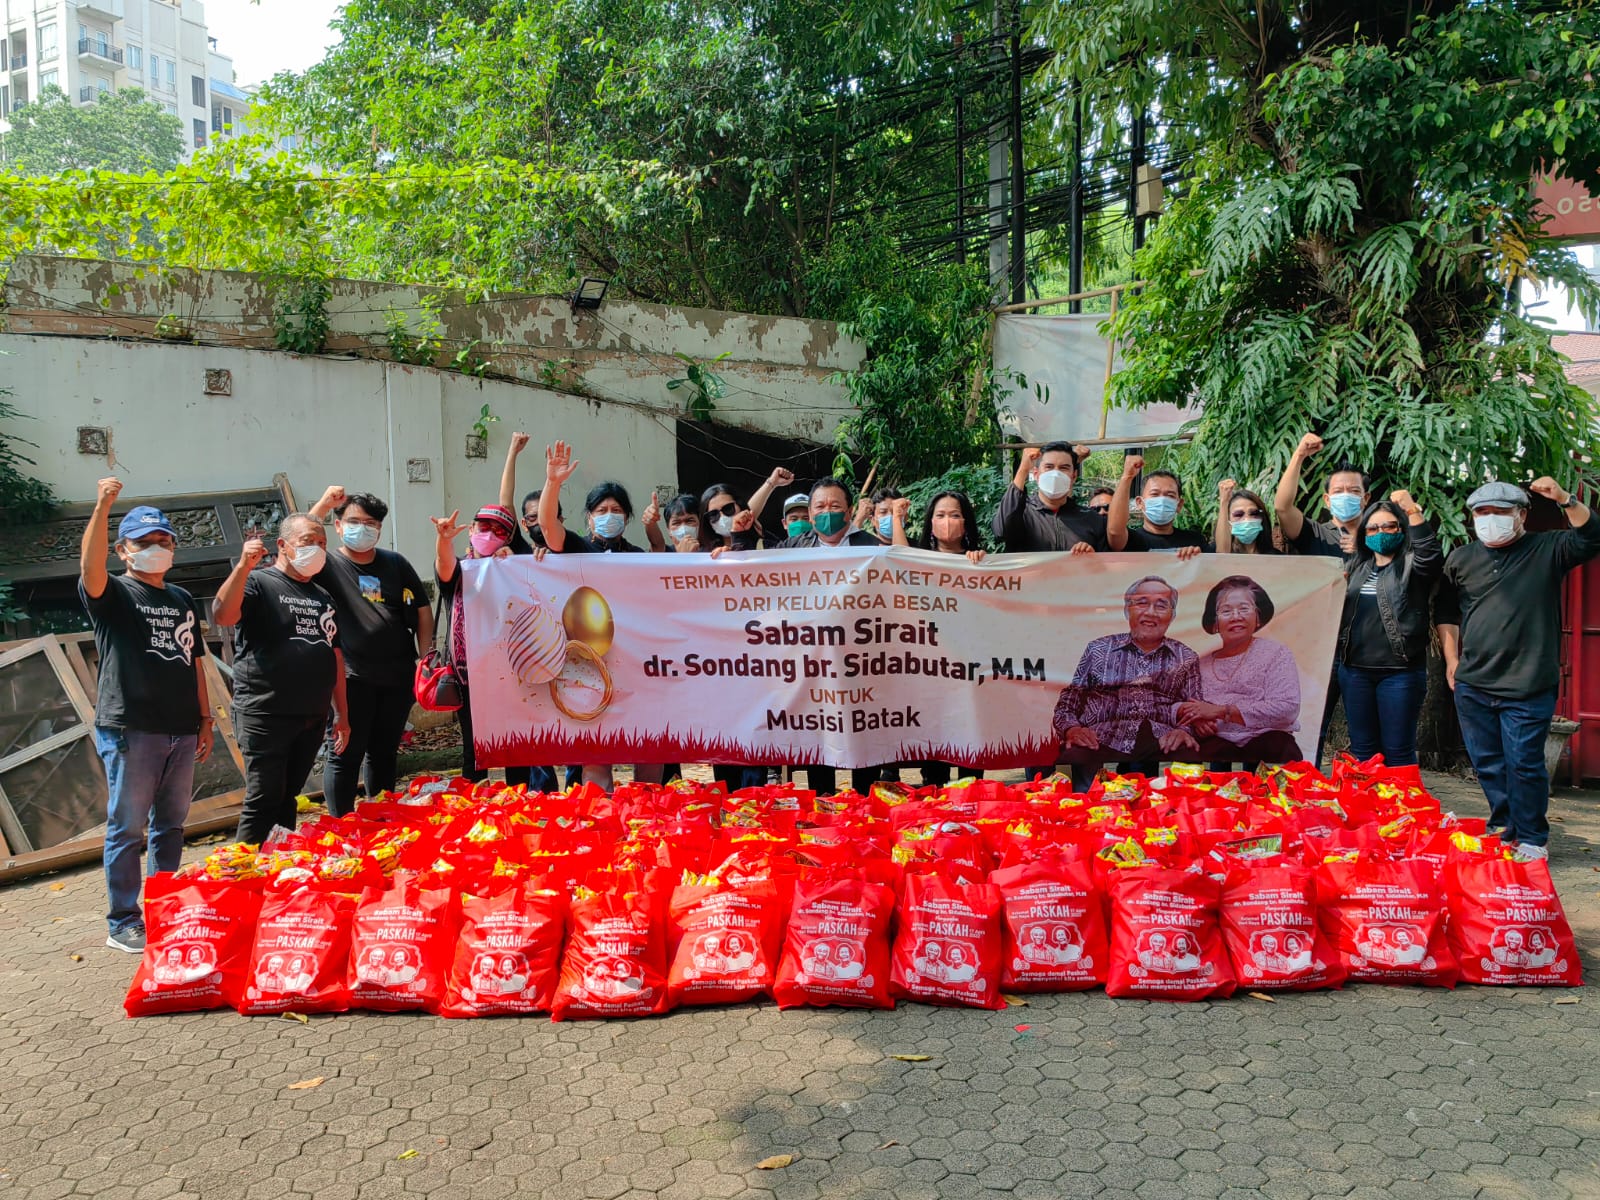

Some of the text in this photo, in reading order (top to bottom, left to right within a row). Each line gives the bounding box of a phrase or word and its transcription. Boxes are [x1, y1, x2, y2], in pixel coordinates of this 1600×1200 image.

[660, 569, 1022, 591] TERIMA KASIH ATAS PAKET PASKAH
[279, 594, 322, 607] Komunitas
[724, 594, 958, 612] DARI KELUARGA BESAR
[289, 605, 319, 616] Penulis
[146, 617, 175, 628] enulis
[295, 615, 317, 627] Lagu
[152, 627, 171, 640] Lgu
[295, 625, 320, 635] Batak
[745, 617, 939, 646] Sabam Sirait
[643, 651, 1046, 686] dr. Sondang br. Sidabutar, M.M
[809, 687, 874, 705] UNTUK
[766, 705, 921, 733] Musisi Batak
[701, 896, 727, 906] Sabam
[923, 900, 950, 909] Sabam
[1143, 893, 1171, 901] Sabam
[1173, 896, 1195, 904] Sirait
[812, 902, 838, 910] Sabam
[1030, 906, 1070, 918] PASKAH
[508, 914, 528, 922] Sirait
[1260, 913, 1302, 925] PASKAH
[1369, 907, 1410, 919] PASKAH
[1506, 908, 1546, 921] PASKAH
[708, 915, 744, 928] PASKAH
[1151, 914, 1192, 926] PASKAH
[377, 928, 415, 940] PASKAH
[818, 922, 857, 935] PASKAH
[929, 922, 968, 937] PASKAH
[276, 936, 315, 948] PASKAH
[487, 935, 521, 948] PASKAH
